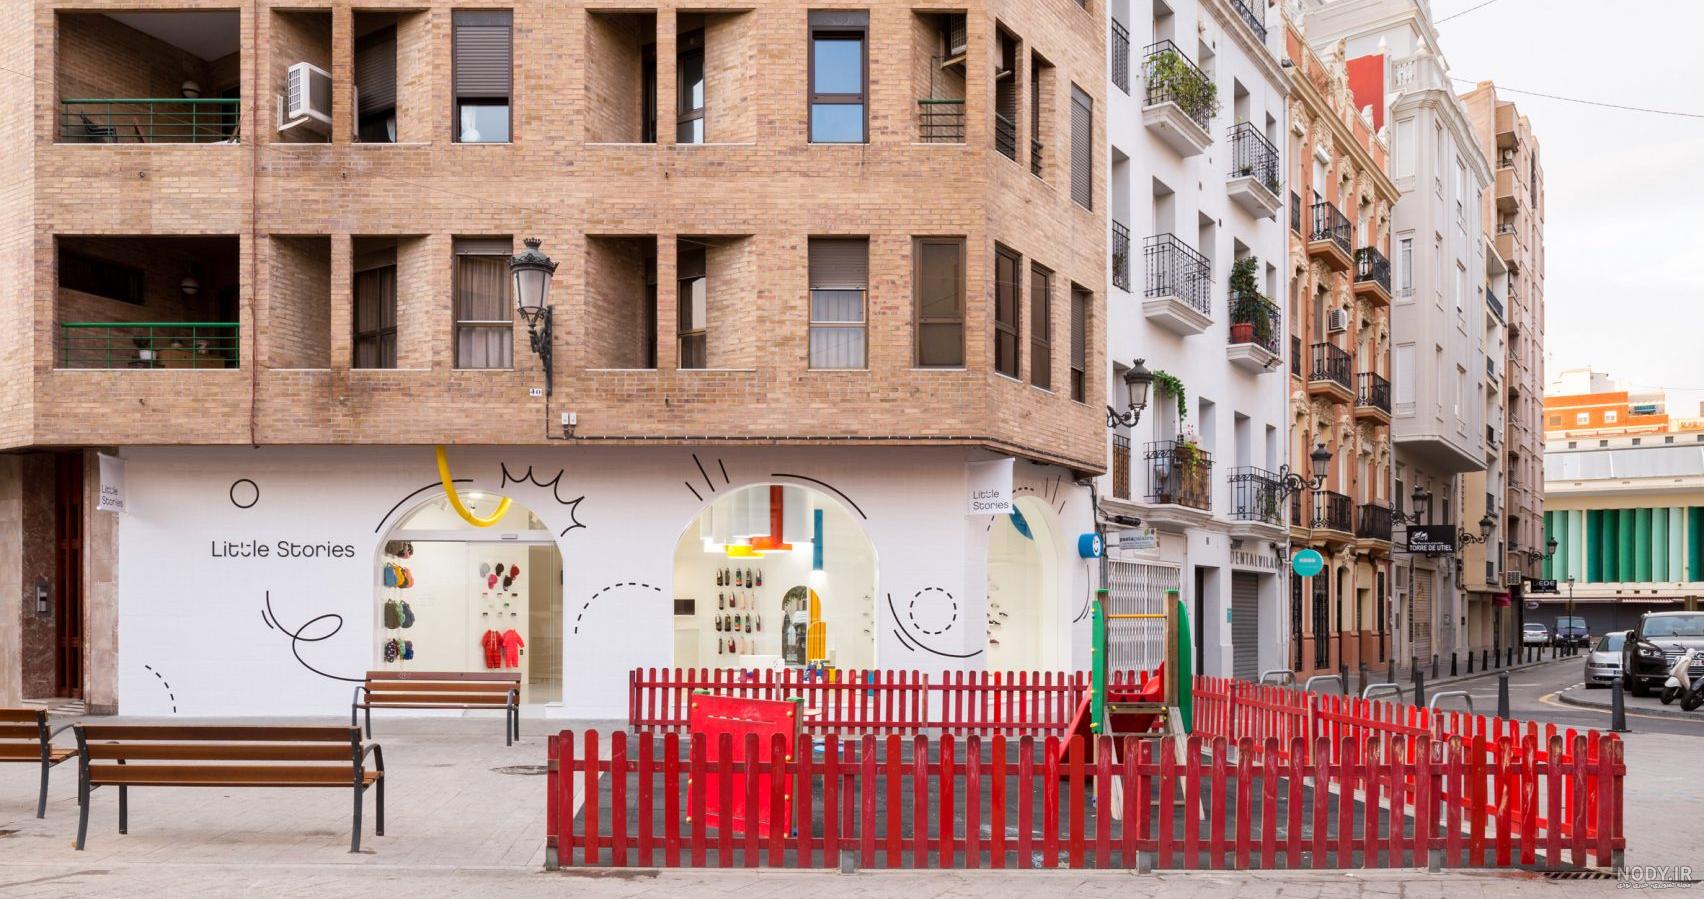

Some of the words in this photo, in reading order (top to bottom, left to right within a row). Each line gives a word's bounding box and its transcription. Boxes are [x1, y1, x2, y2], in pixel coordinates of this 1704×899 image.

[101, 483, 118, 495] Little
[973, 489, 1000, 500] Little
[101, 495, 124, 508] Stories
[973, 500, 1009, 510] Stories
[211, 539, 270, 557] Little
[277, 540, 355, 558] Stories
